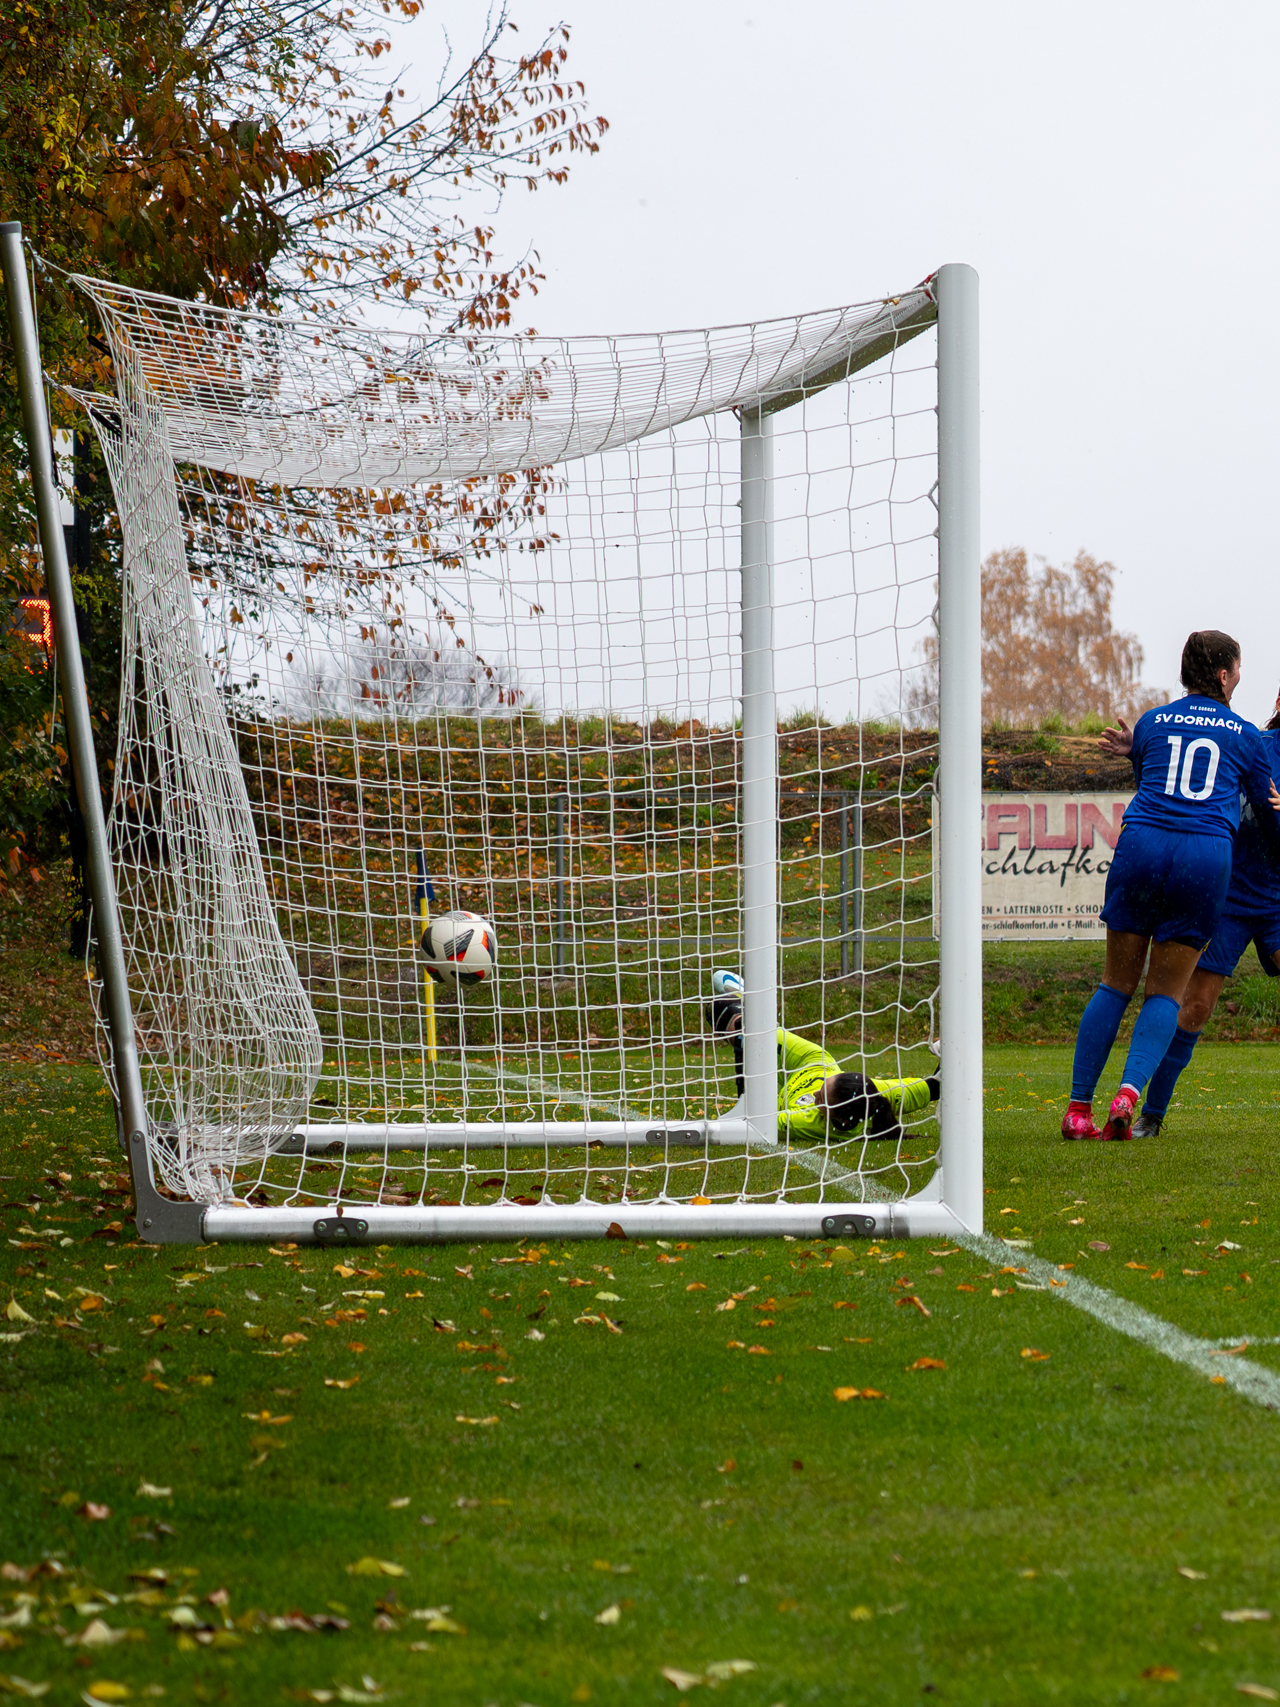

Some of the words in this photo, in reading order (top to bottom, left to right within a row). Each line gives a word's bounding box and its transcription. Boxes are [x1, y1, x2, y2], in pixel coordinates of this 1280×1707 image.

[1155, 713, 1173, 723] SV
[1174, 714, 1242, 734] DORNACH
[1164, 735, 1220, 800] 10
[1003, 905, 1064, 915] LATTENROSTE
[1067, 919, 1096, 930] E-Mail:
